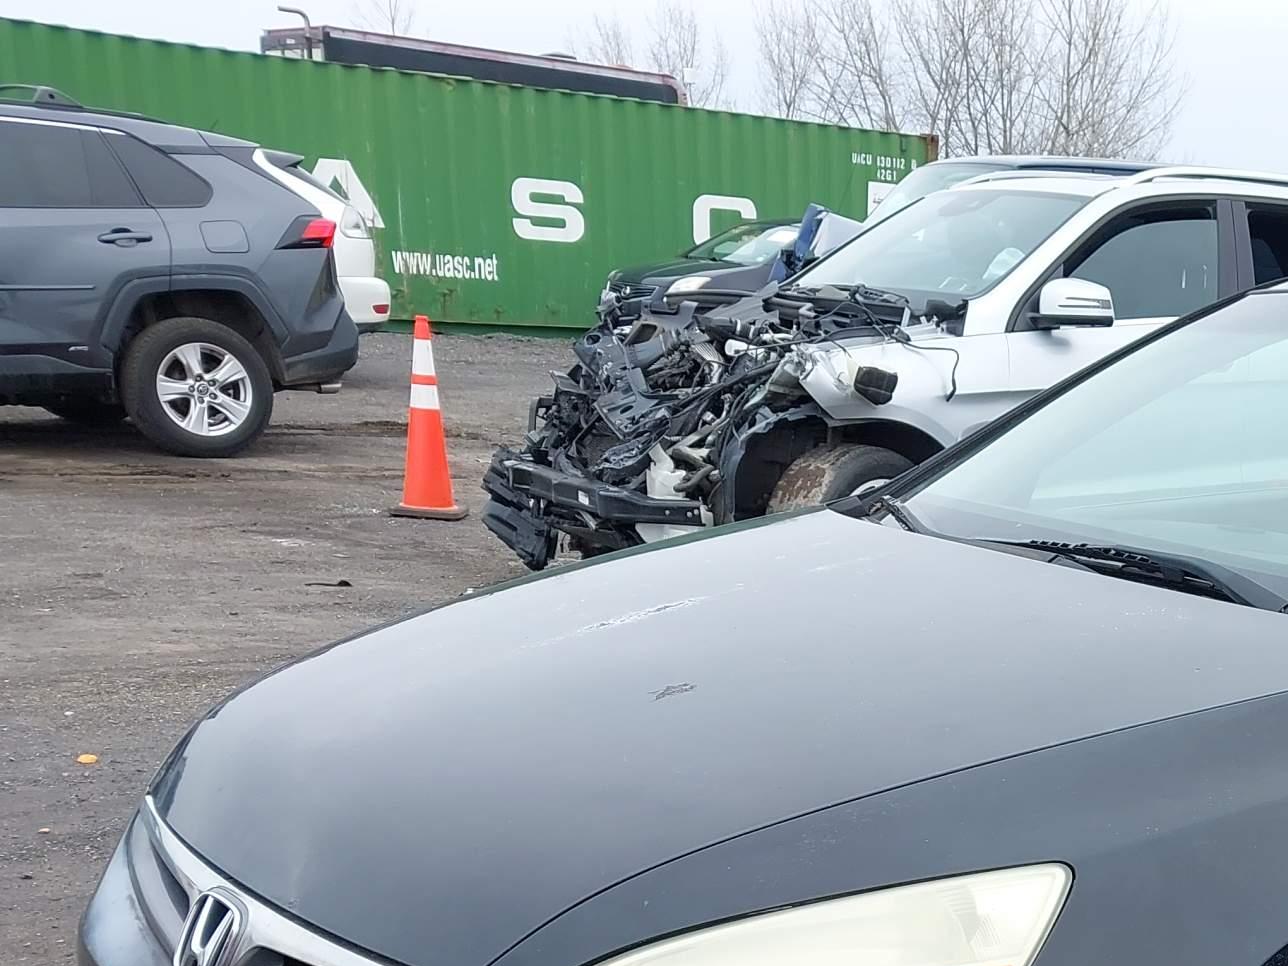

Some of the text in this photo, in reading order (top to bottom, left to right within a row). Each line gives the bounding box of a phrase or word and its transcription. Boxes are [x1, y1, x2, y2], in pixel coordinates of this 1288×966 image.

[311, 158, 386, 229] A
[511, 177, 585, 243] S
[391, 250, 498, 281] www.uasc.net
